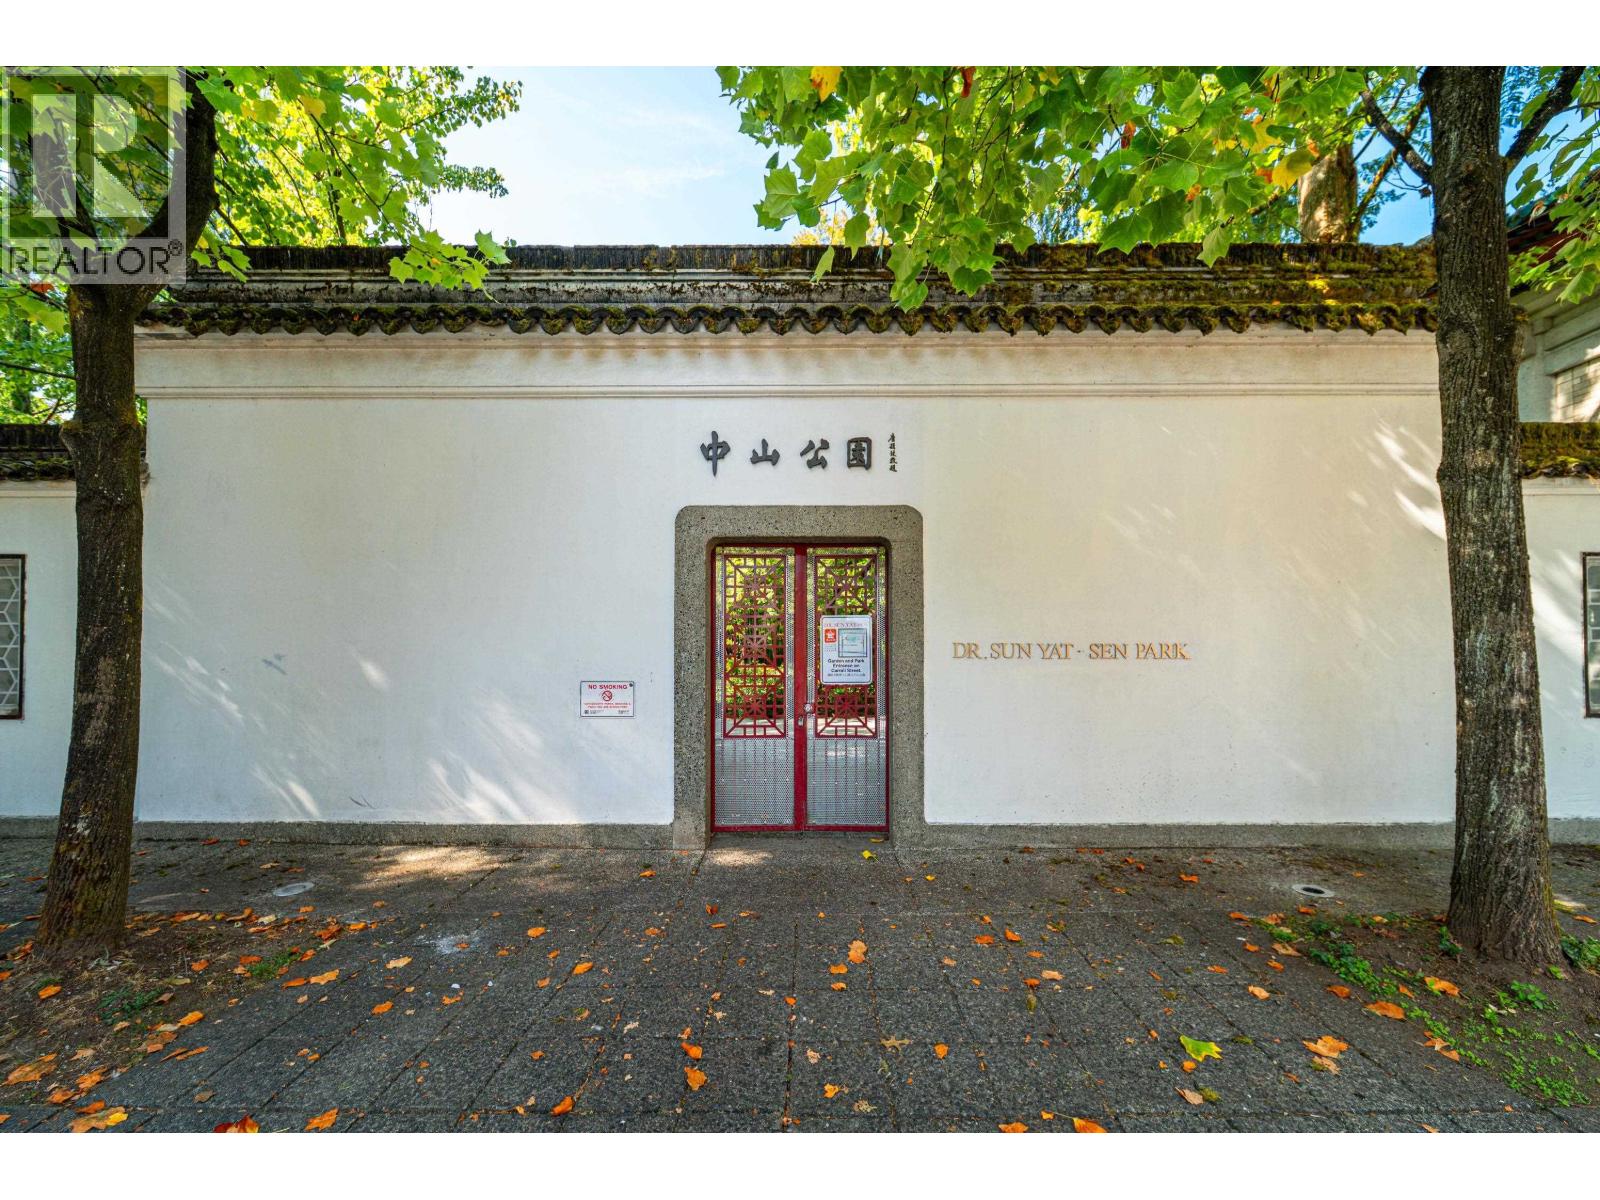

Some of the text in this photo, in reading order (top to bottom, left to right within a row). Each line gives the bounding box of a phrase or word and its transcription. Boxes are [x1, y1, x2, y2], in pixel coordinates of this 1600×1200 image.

[699, 430, 872, 477] 中山公園
[951, 641, 988, 660] DR.
[989, 641, 1032, 660] SUN
[1088, 641, 1129, 660] SEN
[1134, 641, 1192, 660] PARK
